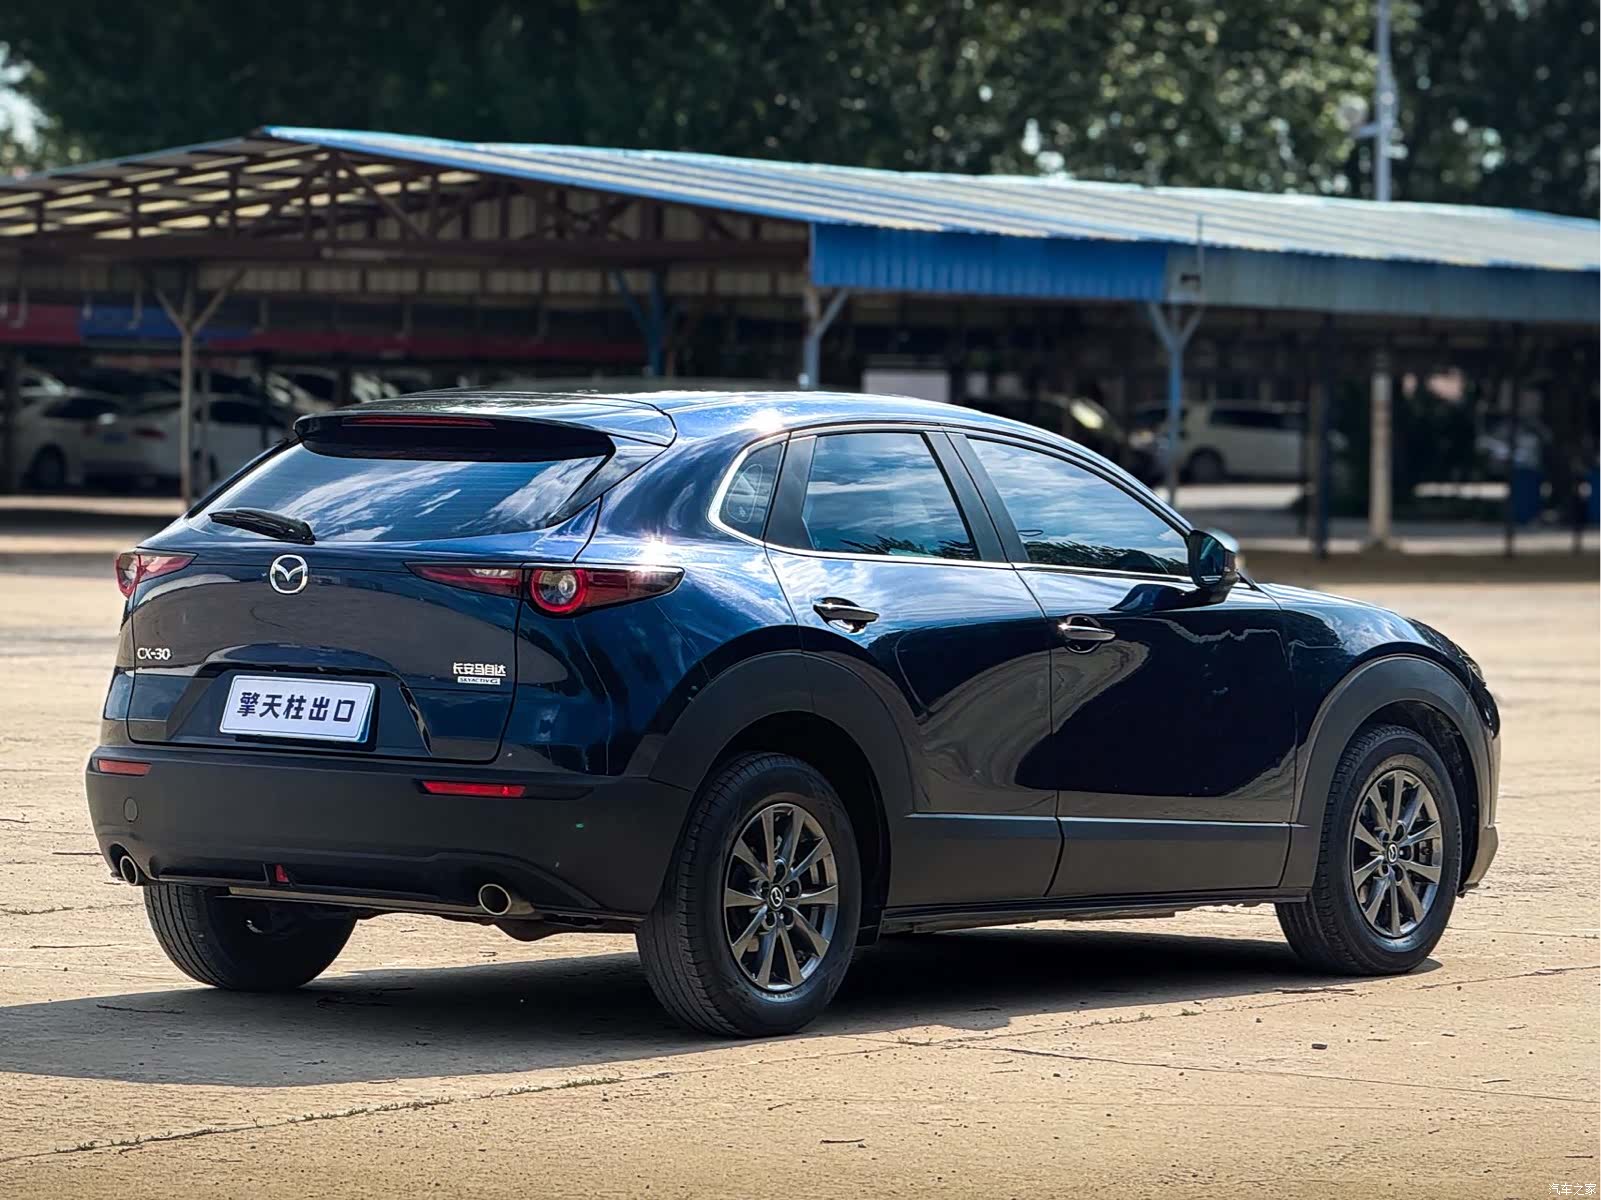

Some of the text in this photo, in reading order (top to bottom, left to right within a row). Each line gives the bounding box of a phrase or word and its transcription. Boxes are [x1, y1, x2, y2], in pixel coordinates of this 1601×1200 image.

[137, 647, 171, 660] CX-30
[453, 662, 506, 676] 长安马自达
[237, 691, 356, 723] 擎天柱出口
